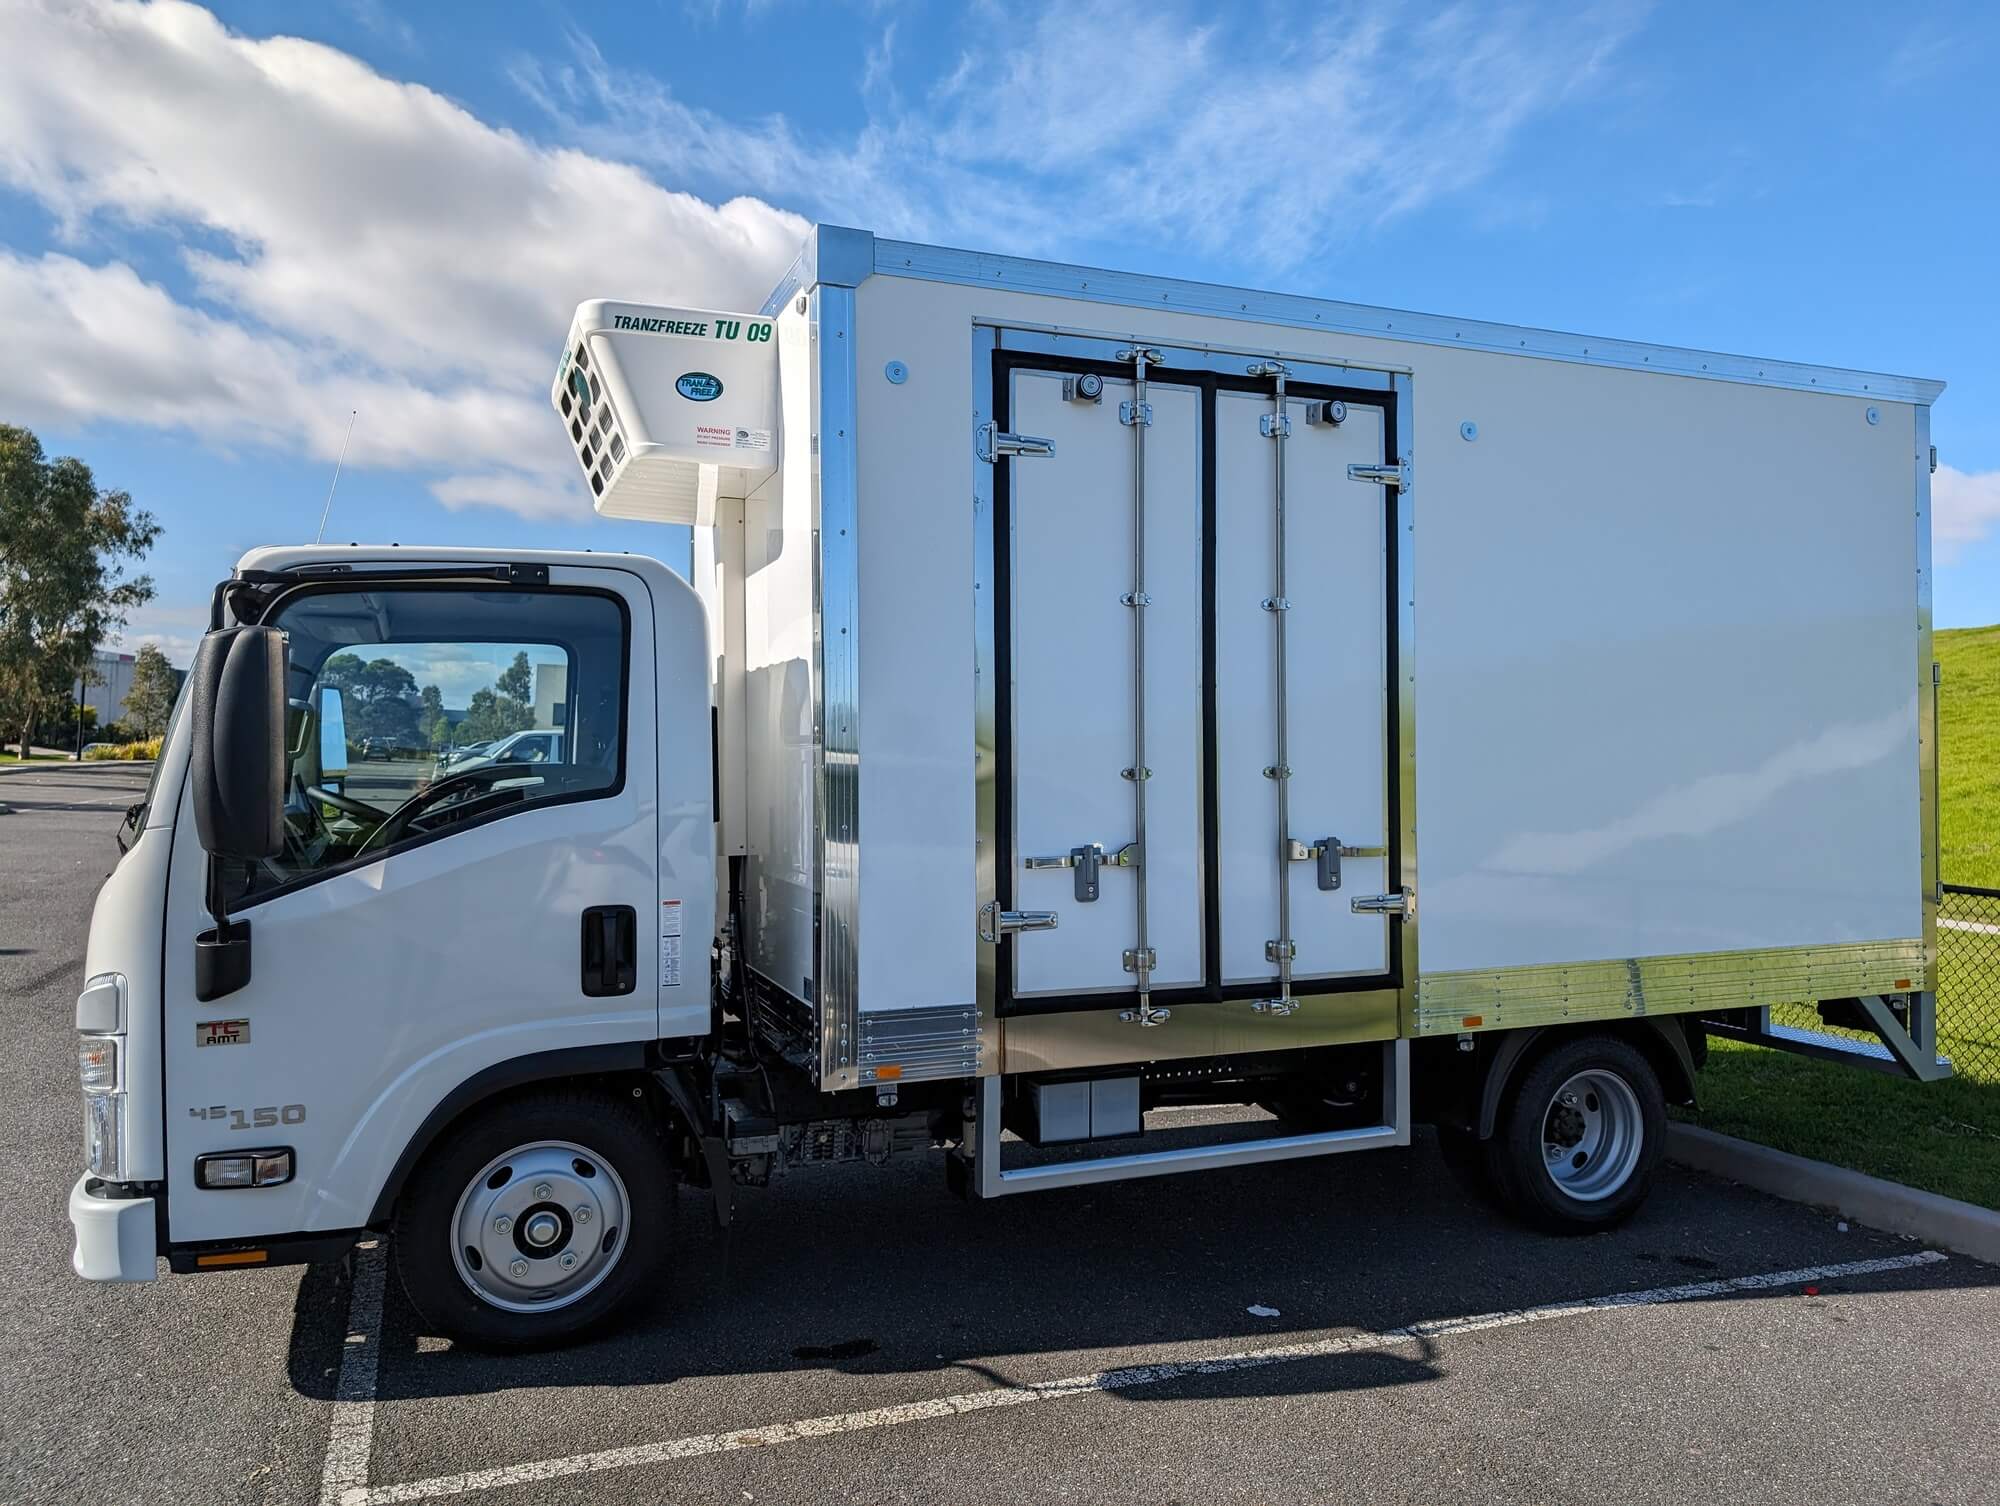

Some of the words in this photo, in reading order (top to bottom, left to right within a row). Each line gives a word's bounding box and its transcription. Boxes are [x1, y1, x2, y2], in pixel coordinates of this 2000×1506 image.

[614, 315, 708, 337] TRANZFREEZE
[715, 320, 741, 340] TU
[747, 323, 772, 343] 09
[697, 426, 731, 436] WARNING
[208, 1020, 240, 1035] TC
[206, 1034, 240, 1045] AMT
[230, 1104, 306, 1130] 150
